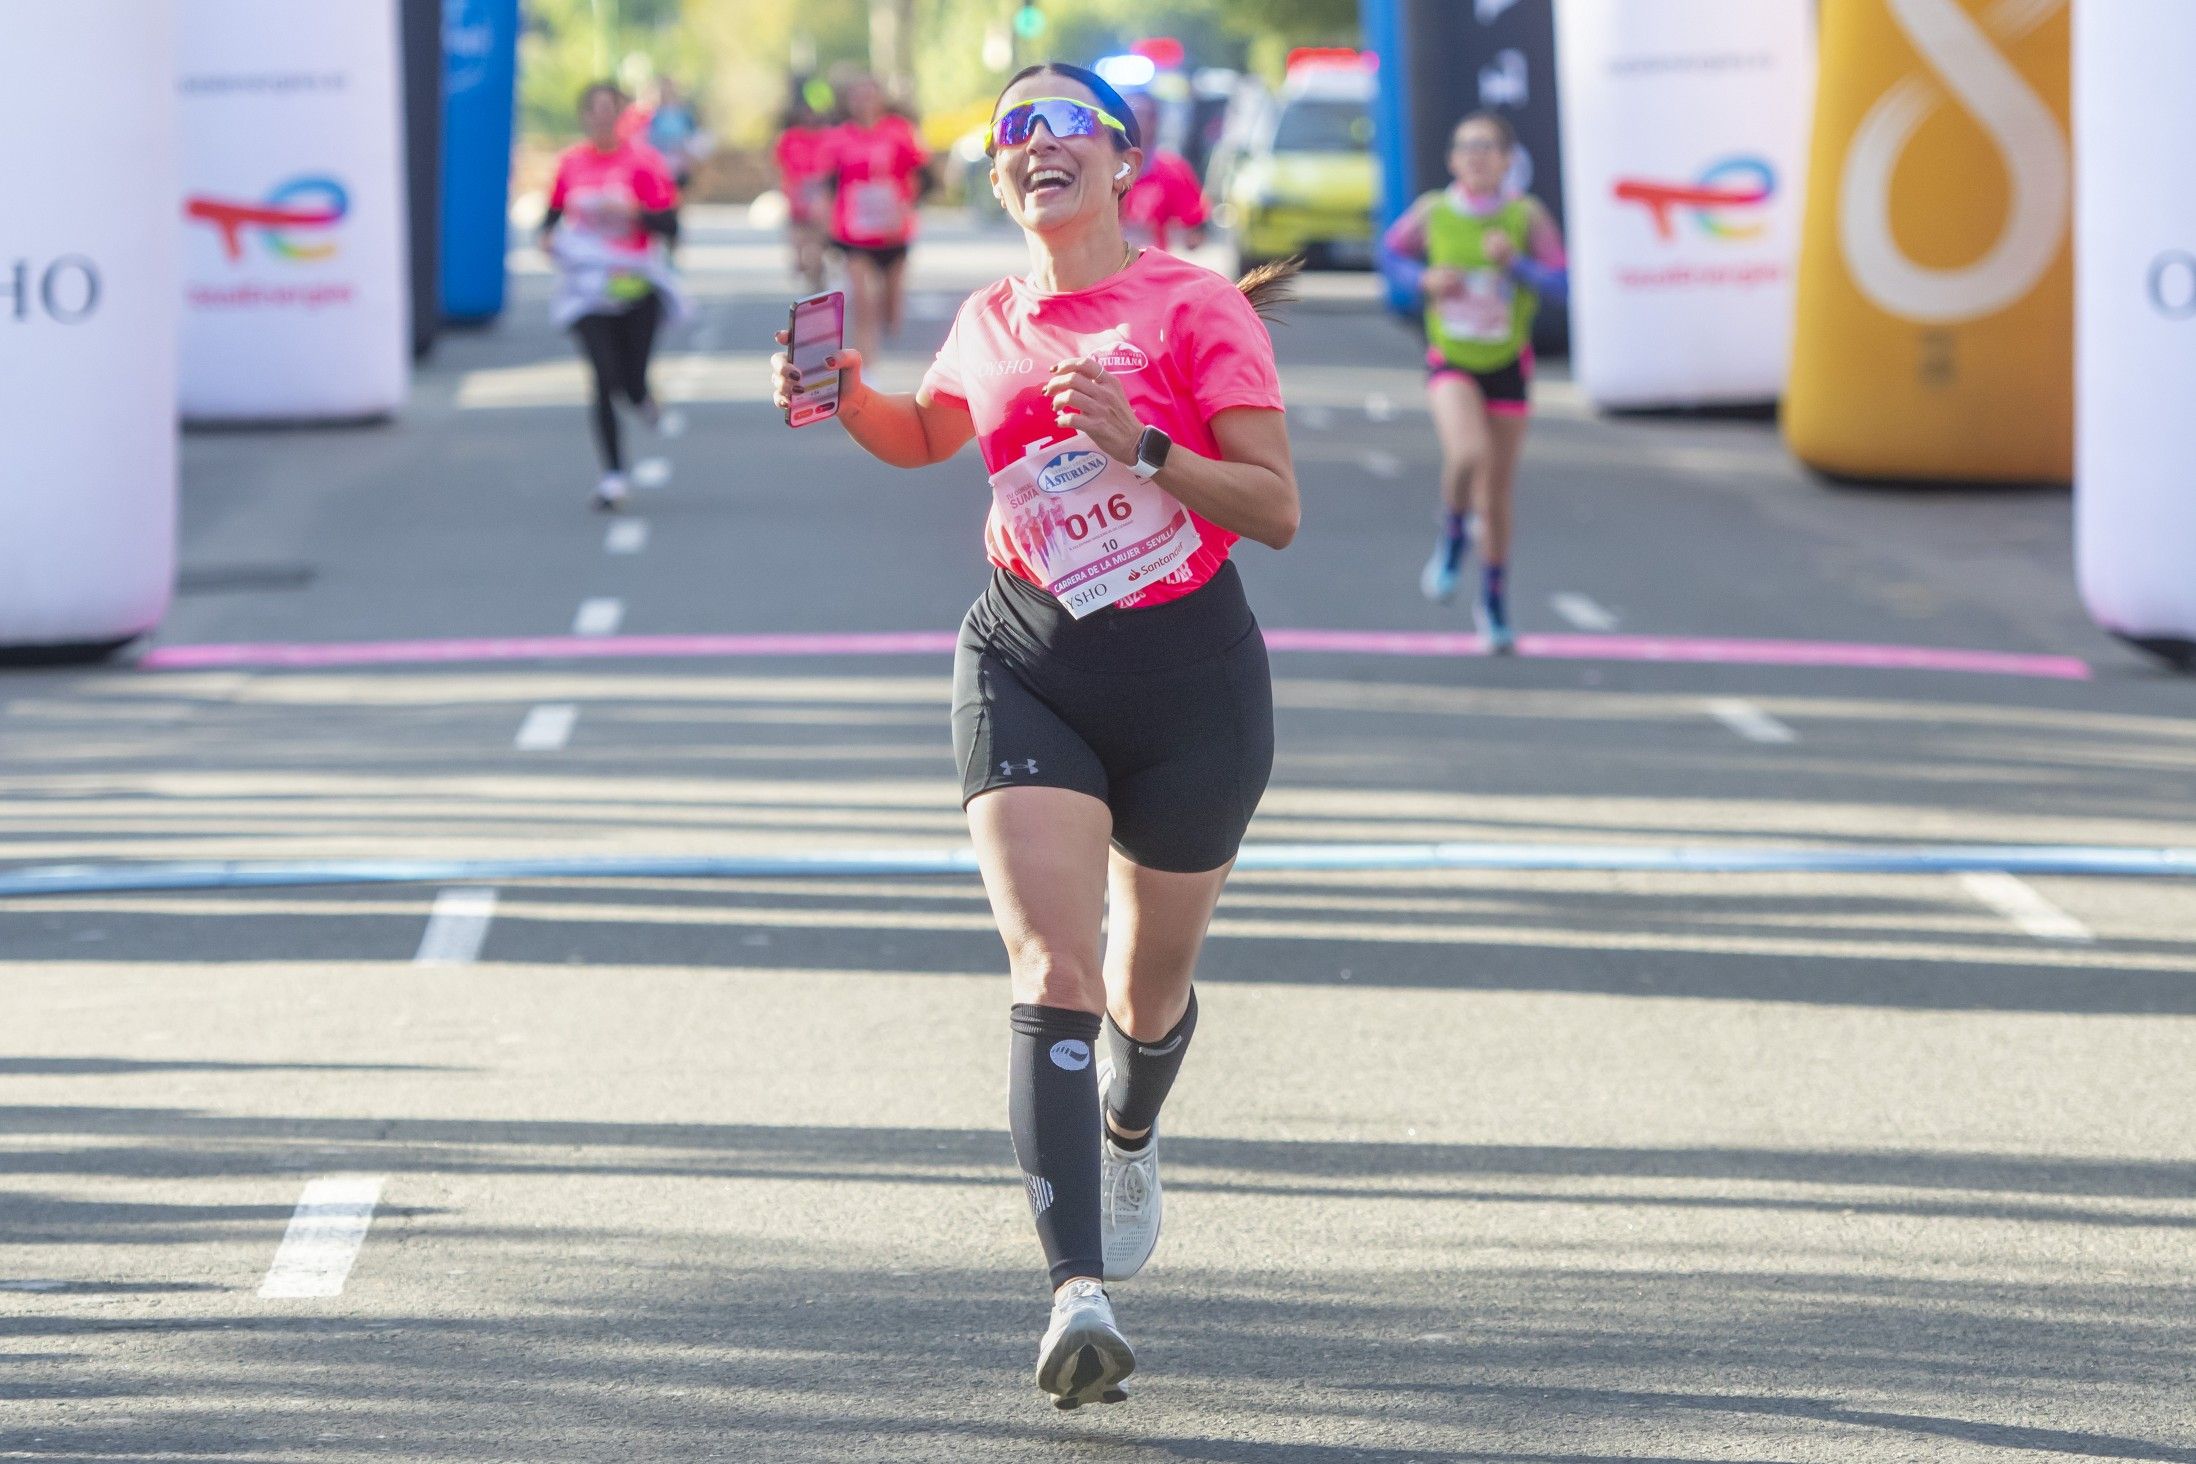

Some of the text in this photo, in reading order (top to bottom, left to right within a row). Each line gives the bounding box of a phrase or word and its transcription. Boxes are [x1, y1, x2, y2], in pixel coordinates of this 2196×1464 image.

[1045, 458, 1104, 490] ASTURIANA
[1010, 488, 1040, 509] SUMA
[1065, 493, 1132, 541] 016
[1102, 538, 1119, 553] 10
[1140, 541, 1183, 576] Santander
[1054, 571, 1088, 593] CARRERA
[1088, 565, 1100, 576] DE
[1100, 560, 1112, 571] LA
[1113, 546, 1141, 566] MUJER
